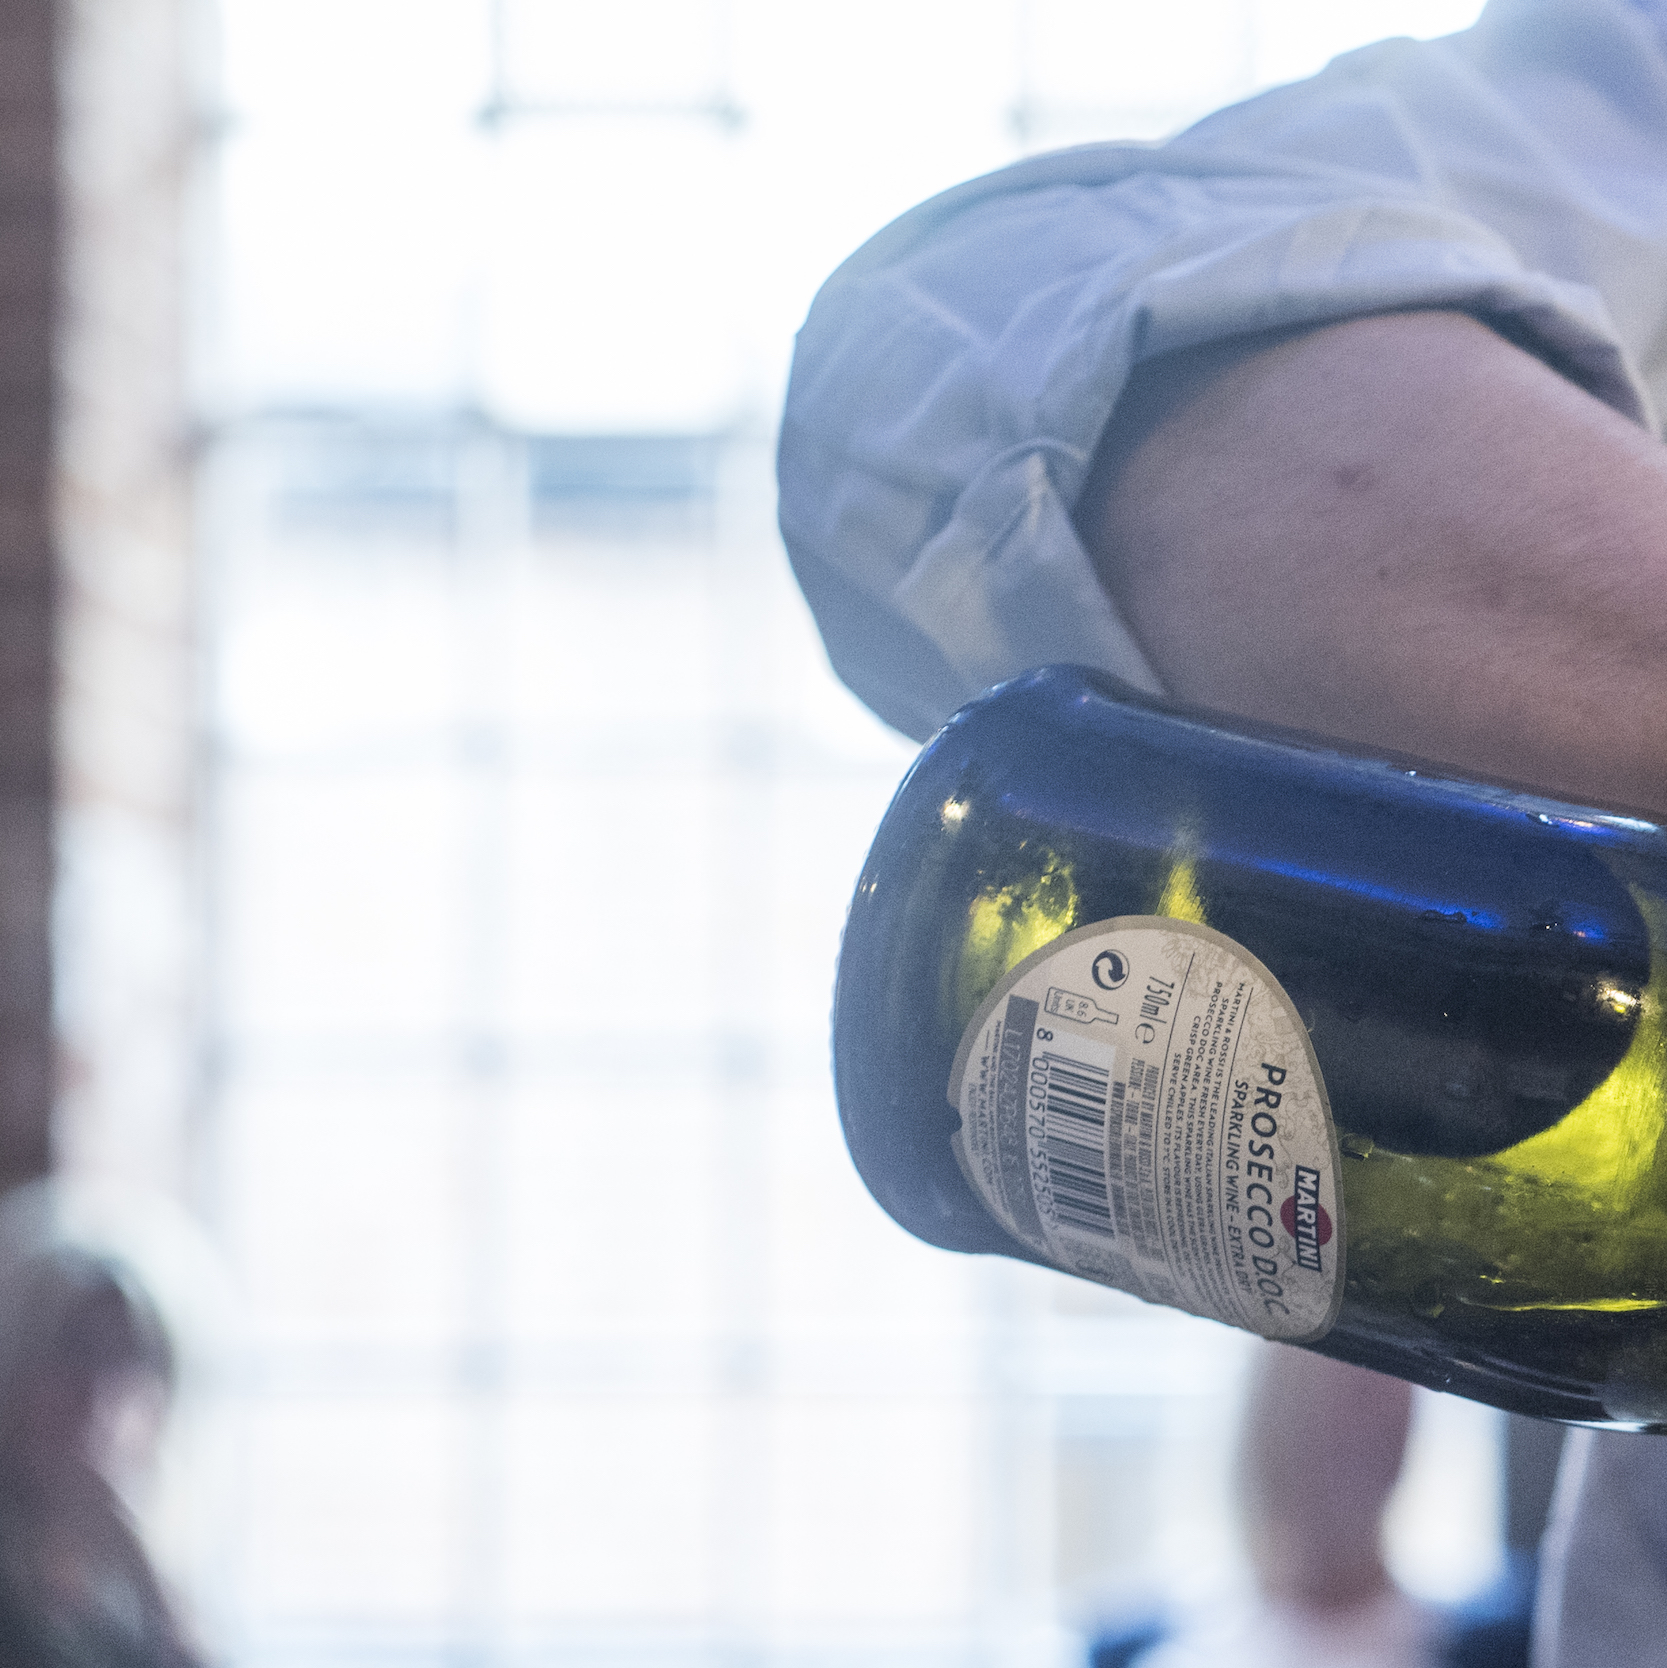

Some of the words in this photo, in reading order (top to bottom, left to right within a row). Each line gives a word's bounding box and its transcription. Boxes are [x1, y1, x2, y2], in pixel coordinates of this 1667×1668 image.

[1139, 976, 1175, 1024] 750ml
[1202, 982, 1222, 1036] PROSECCO
[1228, 982, 1244, 1026] MARTINI
[1036, 1028, 1054, 1042] 8
[1190, 1016, 1201, 1045] CRISP
[1208, 998, 1229, 1055] SPARKLING
[1180, 1048, 1194, 1082] GREEN
[1196, 1039, 1207, 1062] DOC
[1218, 1037, 1231, 1067] ROSSI
[1169, 1053, 1182, 1084] SERVE
[1204, 1058, 1214, 1084] WINE
[1216, 1068, 1224, 1078] IS
[1198, 1086, 1209, 1118] FRESH
[1211, 1080, 1221, 1100] THE
[1165, 1087, 1176, 1129] CHILLED
[1188, 1097, 1197, 1119] THIS
[1207, 1102, 1218, 1146] LEADING
[1164, 1132, 1171, 1145] TO
[1176, 1126, 1184, 1140] ITS
[1196, 1121, 1204, 1152] EVERY
[1226, 1080, 1248, 1171] SPARKLING
[1184, 1122, 1194, 1174] SPARKLING
[1247, 1062, 1287, 1248] PROSECCO
[1163, 1167, 1171, 1195] STORE
[1206, 1148, 1214, 1184] ITALIAN
[1195, 1176, 1203, 1204] USING
[1225, 1175, 1239, 1213] WINE
[1206, 1186, 1216, 1234] SPARKLING
[1297, 1170, 1318, 1268] MARTINI
[1228, 1226, 1244, 1268] EXTRA
[1236, 1270, 1252, 1294] DRY
